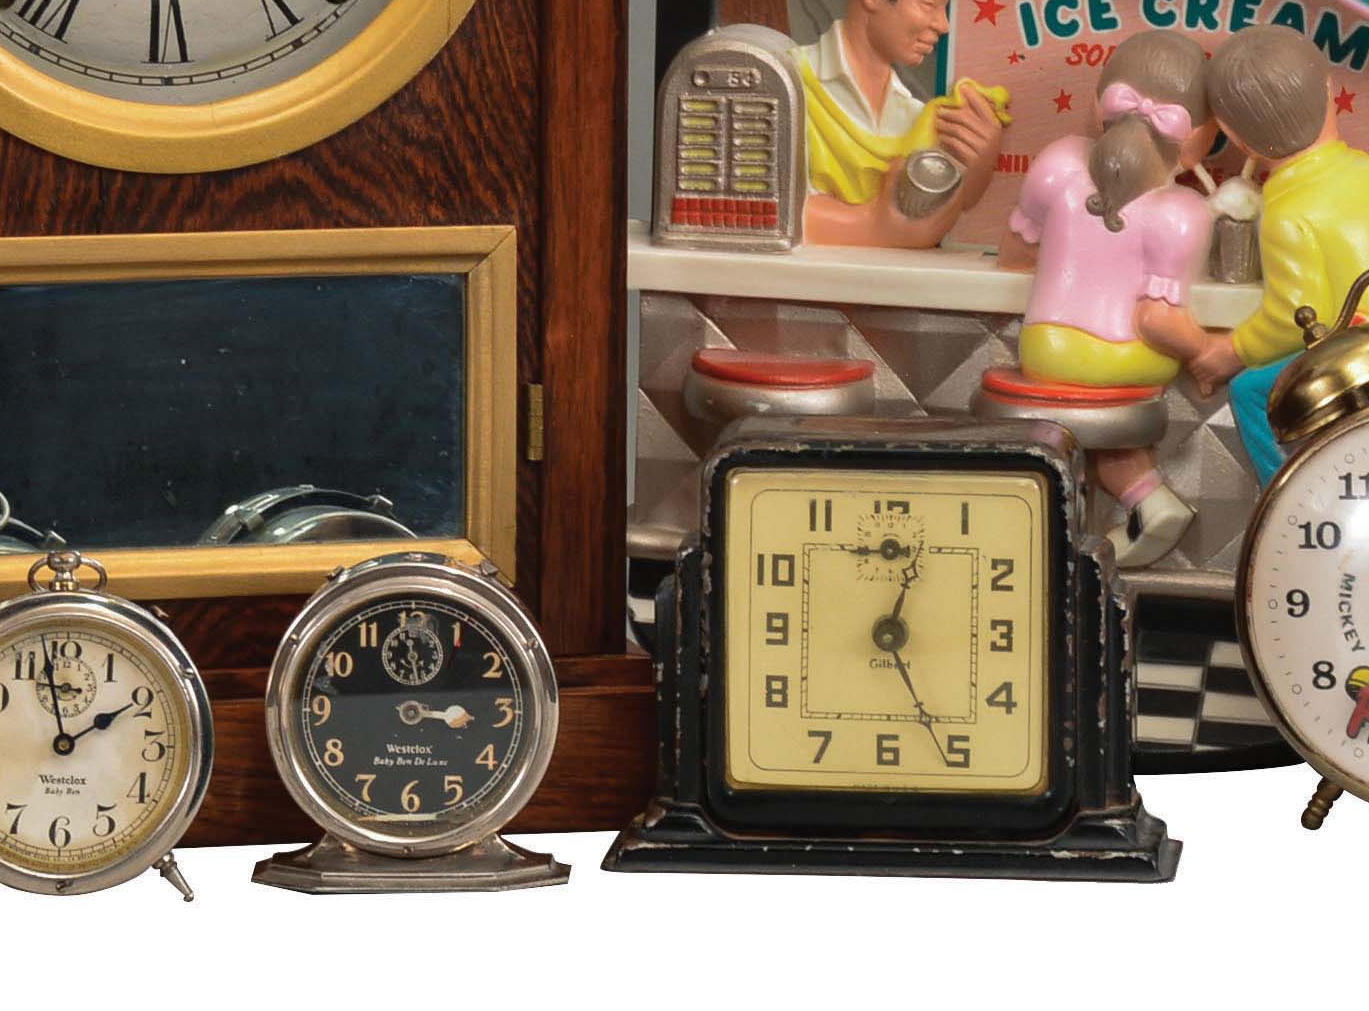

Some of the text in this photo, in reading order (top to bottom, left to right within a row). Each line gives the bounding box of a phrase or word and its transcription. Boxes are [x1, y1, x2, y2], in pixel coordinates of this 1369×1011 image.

[809, 499, 832, 531] 11
[961, 502, 969, 535] 1
[1298, 522, 1341, 550] 10
[758, 554, 794, 586] 10
[991, 559, 1014, 591] 2
[1287, 590, 1310, 617] 9
[1336, 574, 1365, 653] MICKEY
[358, 622, 377, 647] 11
[453, 622, 461, 647] 1
[766, 612, 789, 645] 9
[990, 620, 1013, 652] 3
[13, 651, 36, 680] 11
[103, 653, 118, 682] 1
[326, 652, 353, 677] 10
[483, 652, 502, 678] 2
[1312, 661, 1336, 690] 8
[132, 687, 154, 719] 2
[765, 675, 788, 708] 8
[986, 682, 1017, 714] 4
[313, 696, 331, 725] 9
[493, 698, 514, 727] 3
[142, 731, 166, 762] 3
[324, 739, 344, 765] 8
[386, 743, 433, 754] Westclox
[475, 744, 497, 770] 4
[808, 730, 832, 763] 7
[877, 734, 900, 766] 6
[948, 735, 970, 768] 5
[39, 774, 87, 785] Westclox
[127, 772, 150, 804] 4
[355, 774, 376, 802] 7
[444, 776, 463, 806] 5
[401, 780, 421, 812] 6
[6, 803, 27, 834] 7
[49, 817, 71, 847] 6
[93, 804, 116, 837] 5
